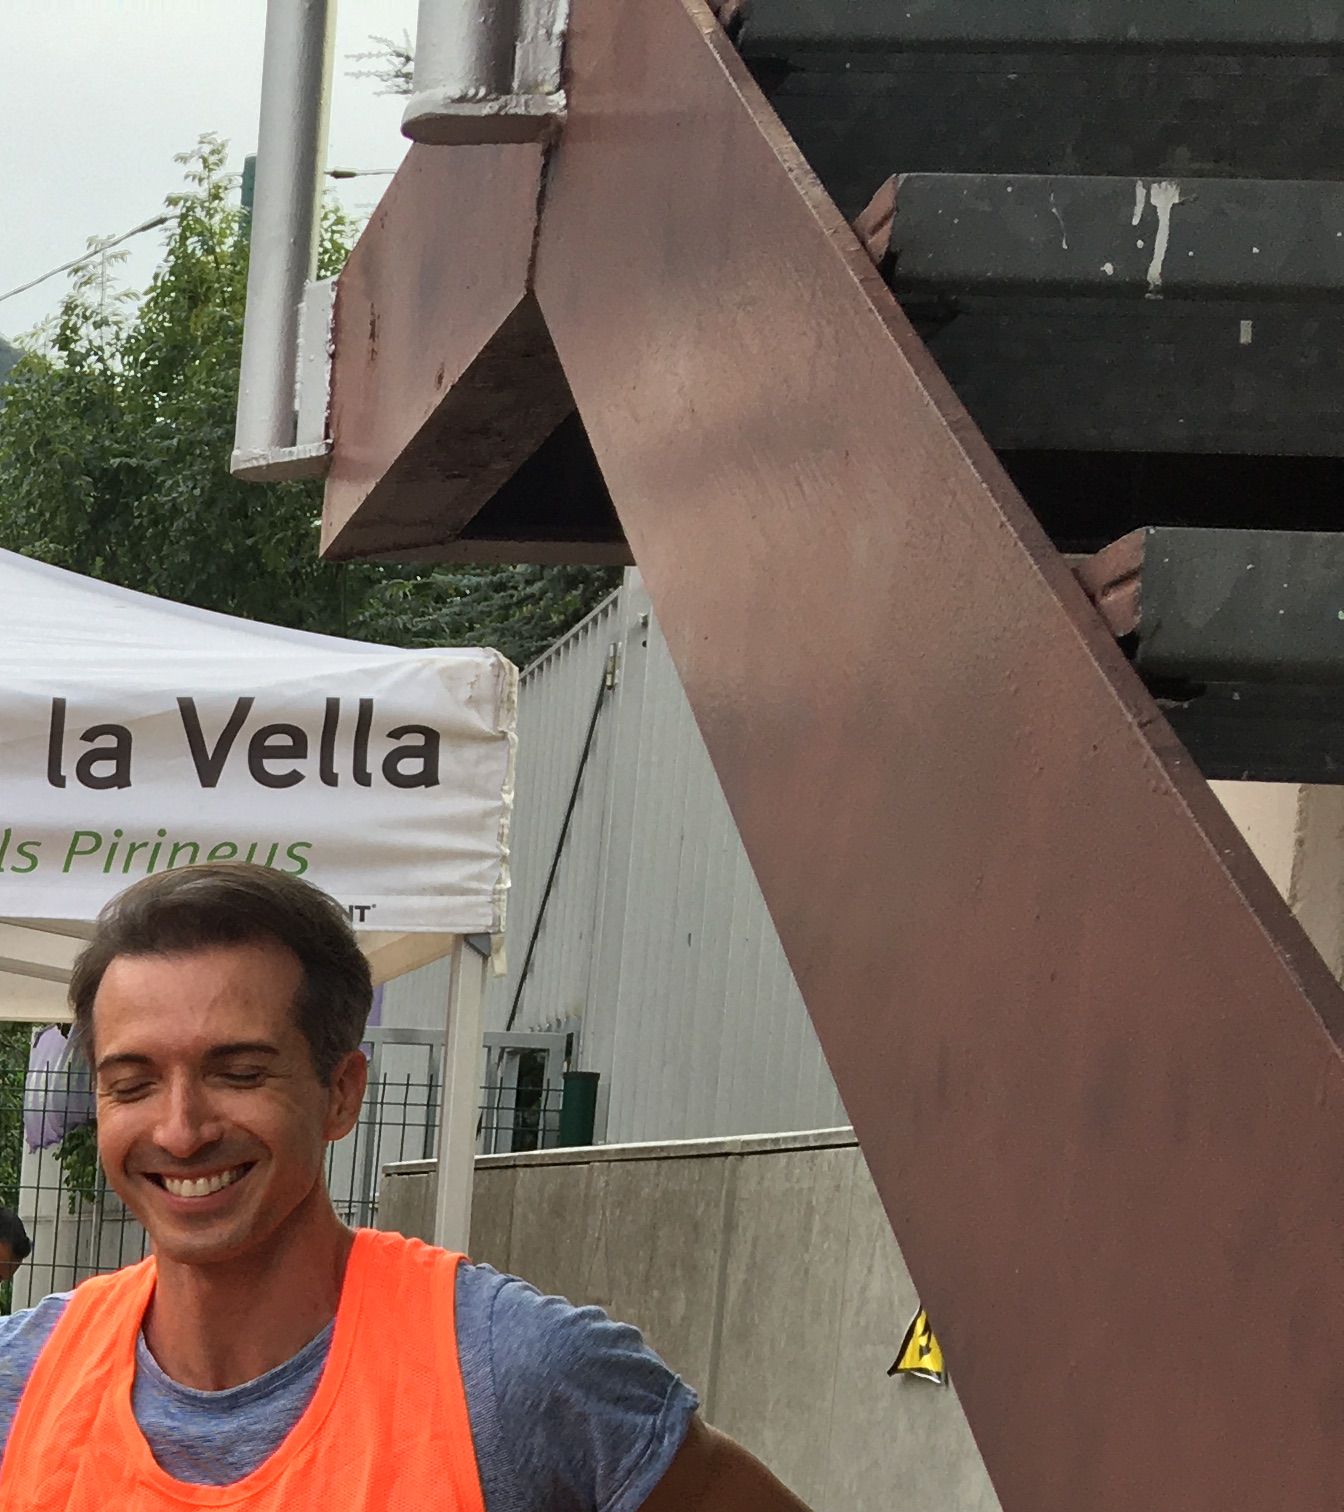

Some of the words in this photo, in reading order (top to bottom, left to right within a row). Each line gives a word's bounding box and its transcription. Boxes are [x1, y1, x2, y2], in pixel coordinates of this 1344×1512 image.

[47, 696, 132, 790] la
[176, 696, 441, 790] Vella
[62, 828, 313, 878] Pirineus
